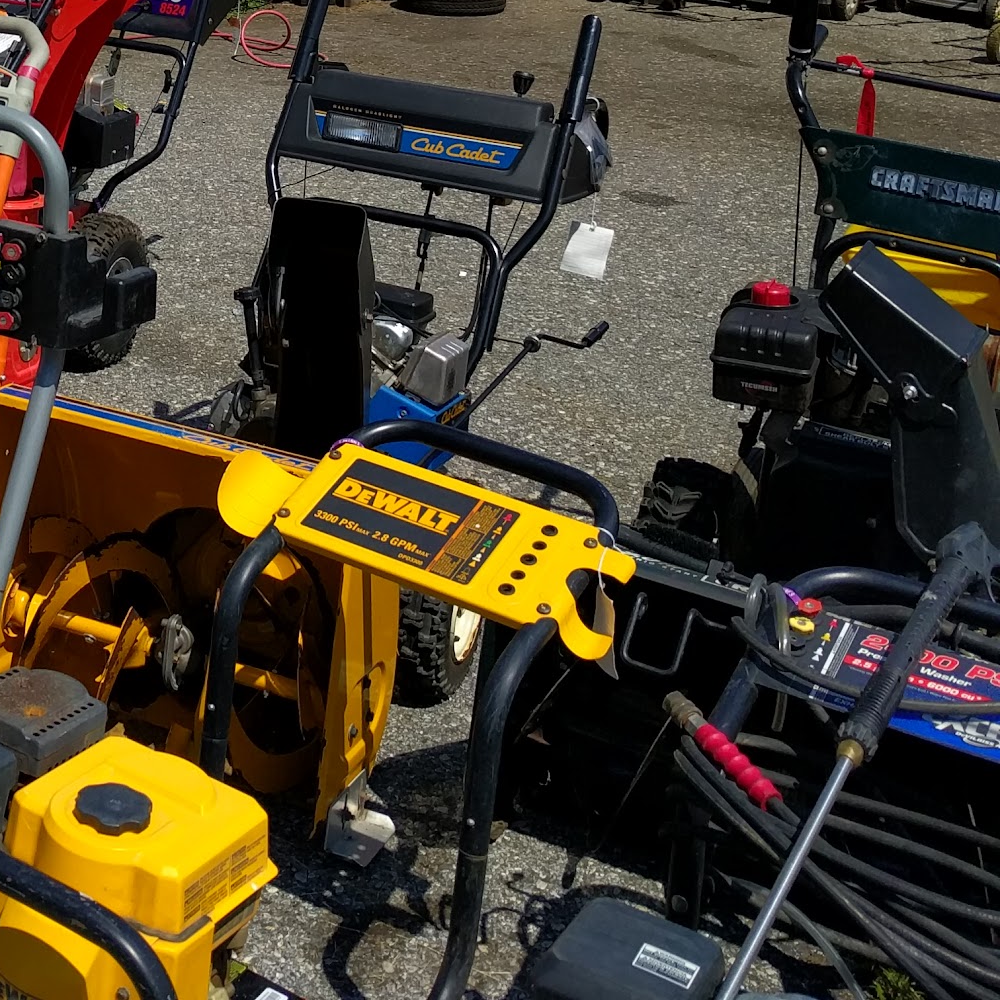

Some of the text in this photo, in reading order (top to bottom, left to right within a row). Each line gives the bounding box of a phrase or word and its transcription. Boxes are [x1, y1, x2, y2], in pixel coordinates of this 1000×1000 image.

[159, 2, 187, 17] 8524
[411, 138, 505, 165] Cub Cadet
[313, 509, 430, 559] 3300 PSI MAX 2.8 GPM MAX
[920, 666, 972, 688] Washer
[926, 681, 960, 696] 6000
